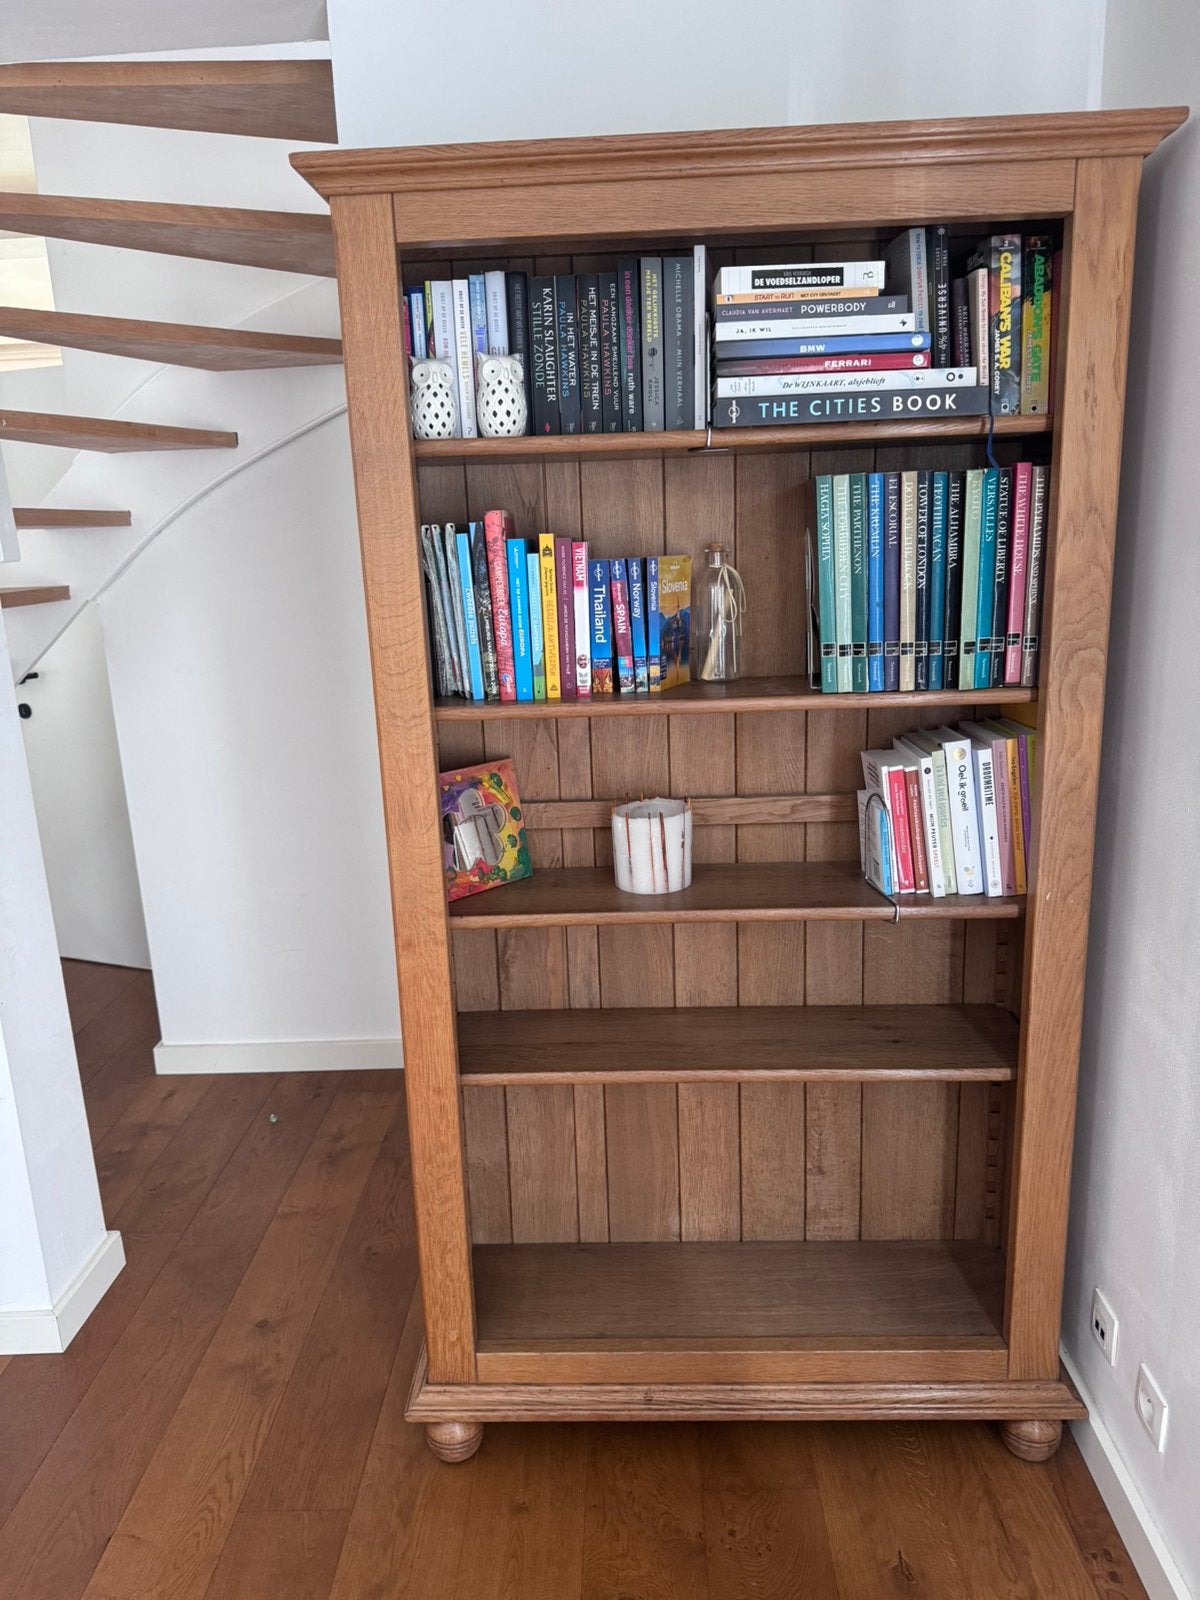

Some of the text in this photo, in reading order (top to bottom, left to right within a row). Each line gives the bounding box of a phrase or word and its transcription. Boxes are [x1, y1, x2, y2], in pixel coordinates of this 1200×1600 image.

[624, 271, 632, 279] in
[674, 263, 682, 303] MICHELLE
[754, 276, 841, 286] DE VOEDSELZANDLOPER
[610, 302, 618, 343] LANGZAAM
[625, 295, 634, 325] donker
[801, 302, 867, 314] POWERBODY
[938, 284, 948, 333] UNIVERSE
[1000, 252, 1012, 369] CALIBAN'S WAR
[532, 302, 545, 389] STILLE ZONDE
[542, 288, 556, 402] KARIN SLAUGHTER
[559, 302, 570, 398] PAULA HAWKINS
[566, 312, 577, 386] IN HET WATER
[580, 300, 591, 398] PAULA HAWKINS
[588, 287, 600, 410] HET MEISJE IN DE TREIN
[602, 300, 612, 396] PAULA HAWKINS
[626, 326, 635, 353] donker
[800, 344, 826, 353] BMW
[627, 355, 635, 370] bos
[628, 373, 636, 391] ruth
[782, 376, 886, 389] De WIJNKAART, alsjeblieft
[824, 359, 872, 368] FERRARI
[1032, 344, 1042, 383] GATE
[676, 370, 684, 408] VERHAAL
[758, 402, 799, 418] THE
[810, 397, 881, 416] CITIES
[893, 394, 957, 412] BOOK
[871, 481, 881, 560] THE KREMLIN
[889, 479, 898, 549] EL ESCORIAL
[972, 480, 981, 520] KYOTO
[985, 477, 996, 542] VERSAILLES
[820, 484, 831, 561] HAGIA SOPHIA
[837, 483, 849, 601] THE FORBIDDEN CITY
[852, 482, 863, 575] THE PARTHENON
[904, 482, 914, 591] DOME OF THE ROCK
[917, 482, 928, 590] TOWER OF LONDON
[950, 483, 960, 568] THE ALHAMBRA
[996, 477, 1010, 583] STATUE OF LIBERTY
[1014, 472, 1028, 576] THE WHITE HOUSE
[1030, 476, 1045, 605] THE PYRAMIDS AND SPHINX
[576, 547, 585, 581] VIETNAM
[466, 588, 476, 619] Zweedse
[494, 561, 509, 647] CAMPERBOEK Europa
[630, 583, 641, 618] Norway
[650, 581, 658, 611] Slovenia
[662, 578, 688, 594] Slovenia
[593, 584, 607, 644] Thailand
[616, 604, 627, 634] SPAIN
[548, 634, 557, 677] ANTWERPEN
[957, 791, 969, 812] groei!
[959, 782, 967, 790] ik
[982, 762, 994, 806] DROOMRITME
